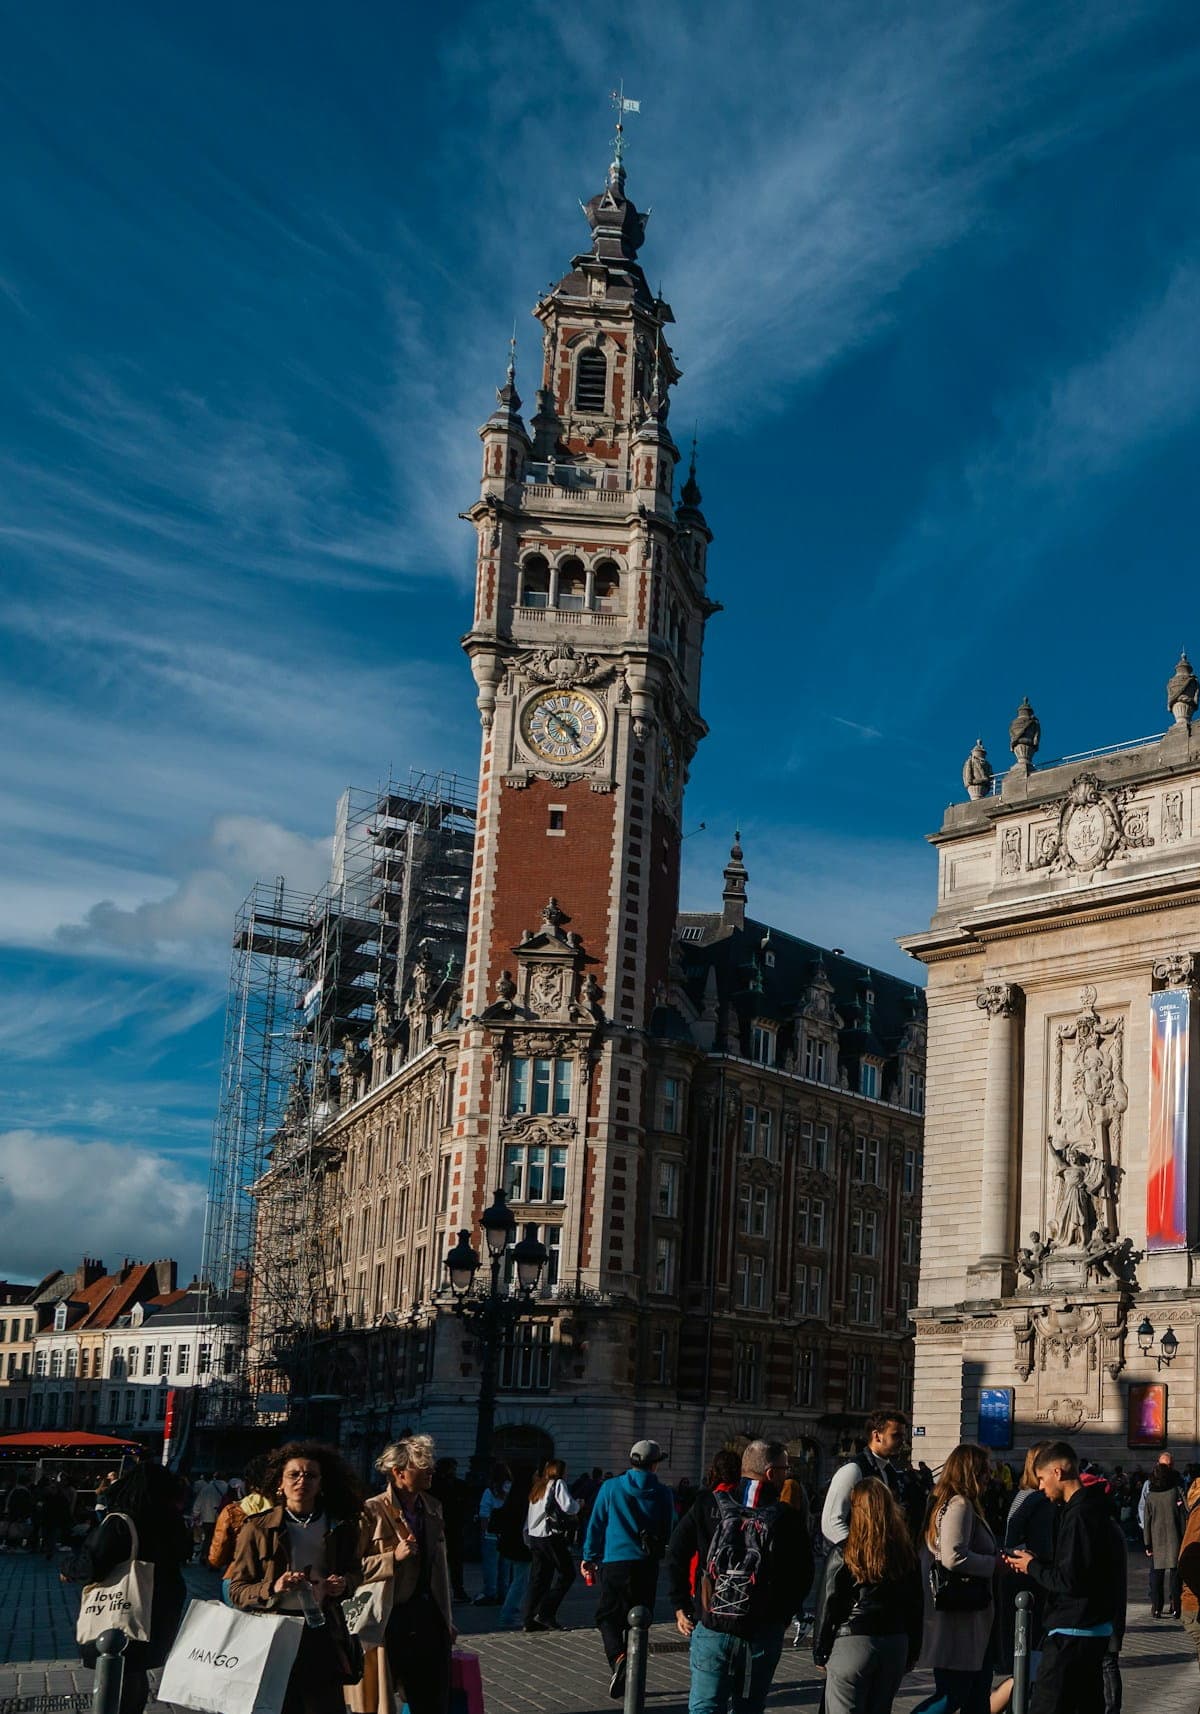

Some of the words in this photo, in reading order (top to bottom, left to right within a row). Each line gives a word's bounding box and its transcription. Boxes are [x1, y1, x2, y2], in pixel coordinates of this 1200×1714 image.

[95, 1591, 122, 1602] love
[85, 1604, 105, 1616] my
[108, 1599, 132, 1612] life
[188, 1647, 239, 1669] MANGO
